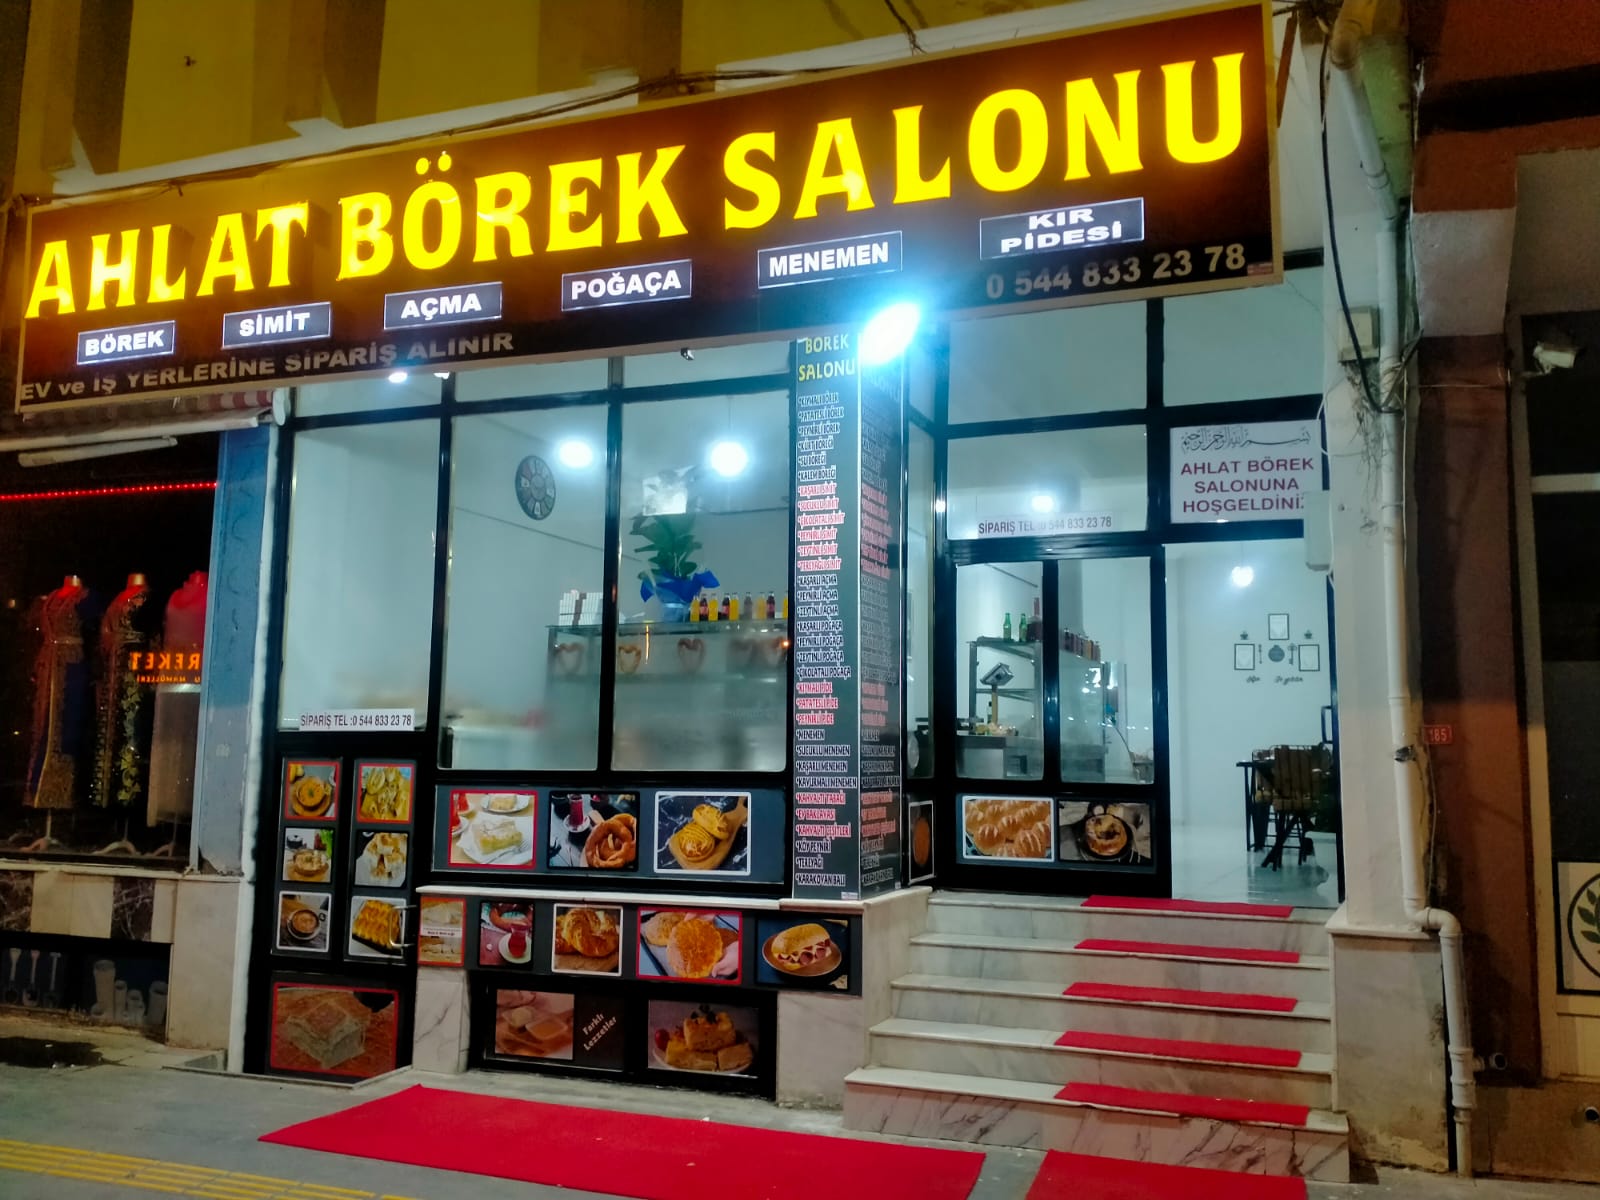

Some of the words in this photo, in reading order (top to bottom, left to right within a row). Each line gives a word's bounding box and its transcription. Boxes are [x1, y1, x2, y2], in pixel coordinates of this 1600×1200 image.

[24, 201, 309, 319] AHLAT
[336, 144, 688, 281] BÖREK
[723, 52, 1245, 230] SALONU
[1028, 206, 1094, 232] KIR
[1000, 220, 1123, 253] PİDESİ
[768, 241, 889, 278] MENEMEN
[986, 273, 1004, 298] 0
[1014, 265, 1072, 296] 544
[1082, 257, 1142, 288] 833
[1152, 250, 1193, 280] 23
[1205, 243, 1246, 274] 78
[571, 267, 682, 302] POĞAÇA
[401, 292, 482, 321] AÇMA
[239, 310, 311, 337] SİMİT
[85, 329, 164, 356] BÖREK
[22, 381, 51, 401] EV
[58, 379, 85, 396] ve
[127, 356, 275, 389] YERLERİNE
[285, 339, 397, 374] SİPARİŞ
[407, 332, 514, 360] ALINIR
[799, 358, 856, 382] SALONU
[1181, 461, 1241, 475] AHLAT
[1248, 456, 1314, 472] BÖREK
[1194, 478, 1299, 494] SALONUNA
[1183, 494, 1304, 515] HOŞGELDİNİ
[978, 520, 1015, 535] SİPARİŞ
[1018, 520, 1034, 532] TEL
[1067, 518, 1084, 529] 833
[1087, 517, 1098, 528] 23
[1101, 516, 1112, 528] 78
[300, 712, 331, 729] SİPARİŞ
[334, 715, 348, 726] TEL
[359, 715, 373, 726] 544
[374, 715, 389, 726] 833
[390, 715, 400, 726] 23
[402, 715, 411, 726] 78
[582, 1013, 604, 1035] Farklı
[583, 1016, 617, 1051] Lezzetler
